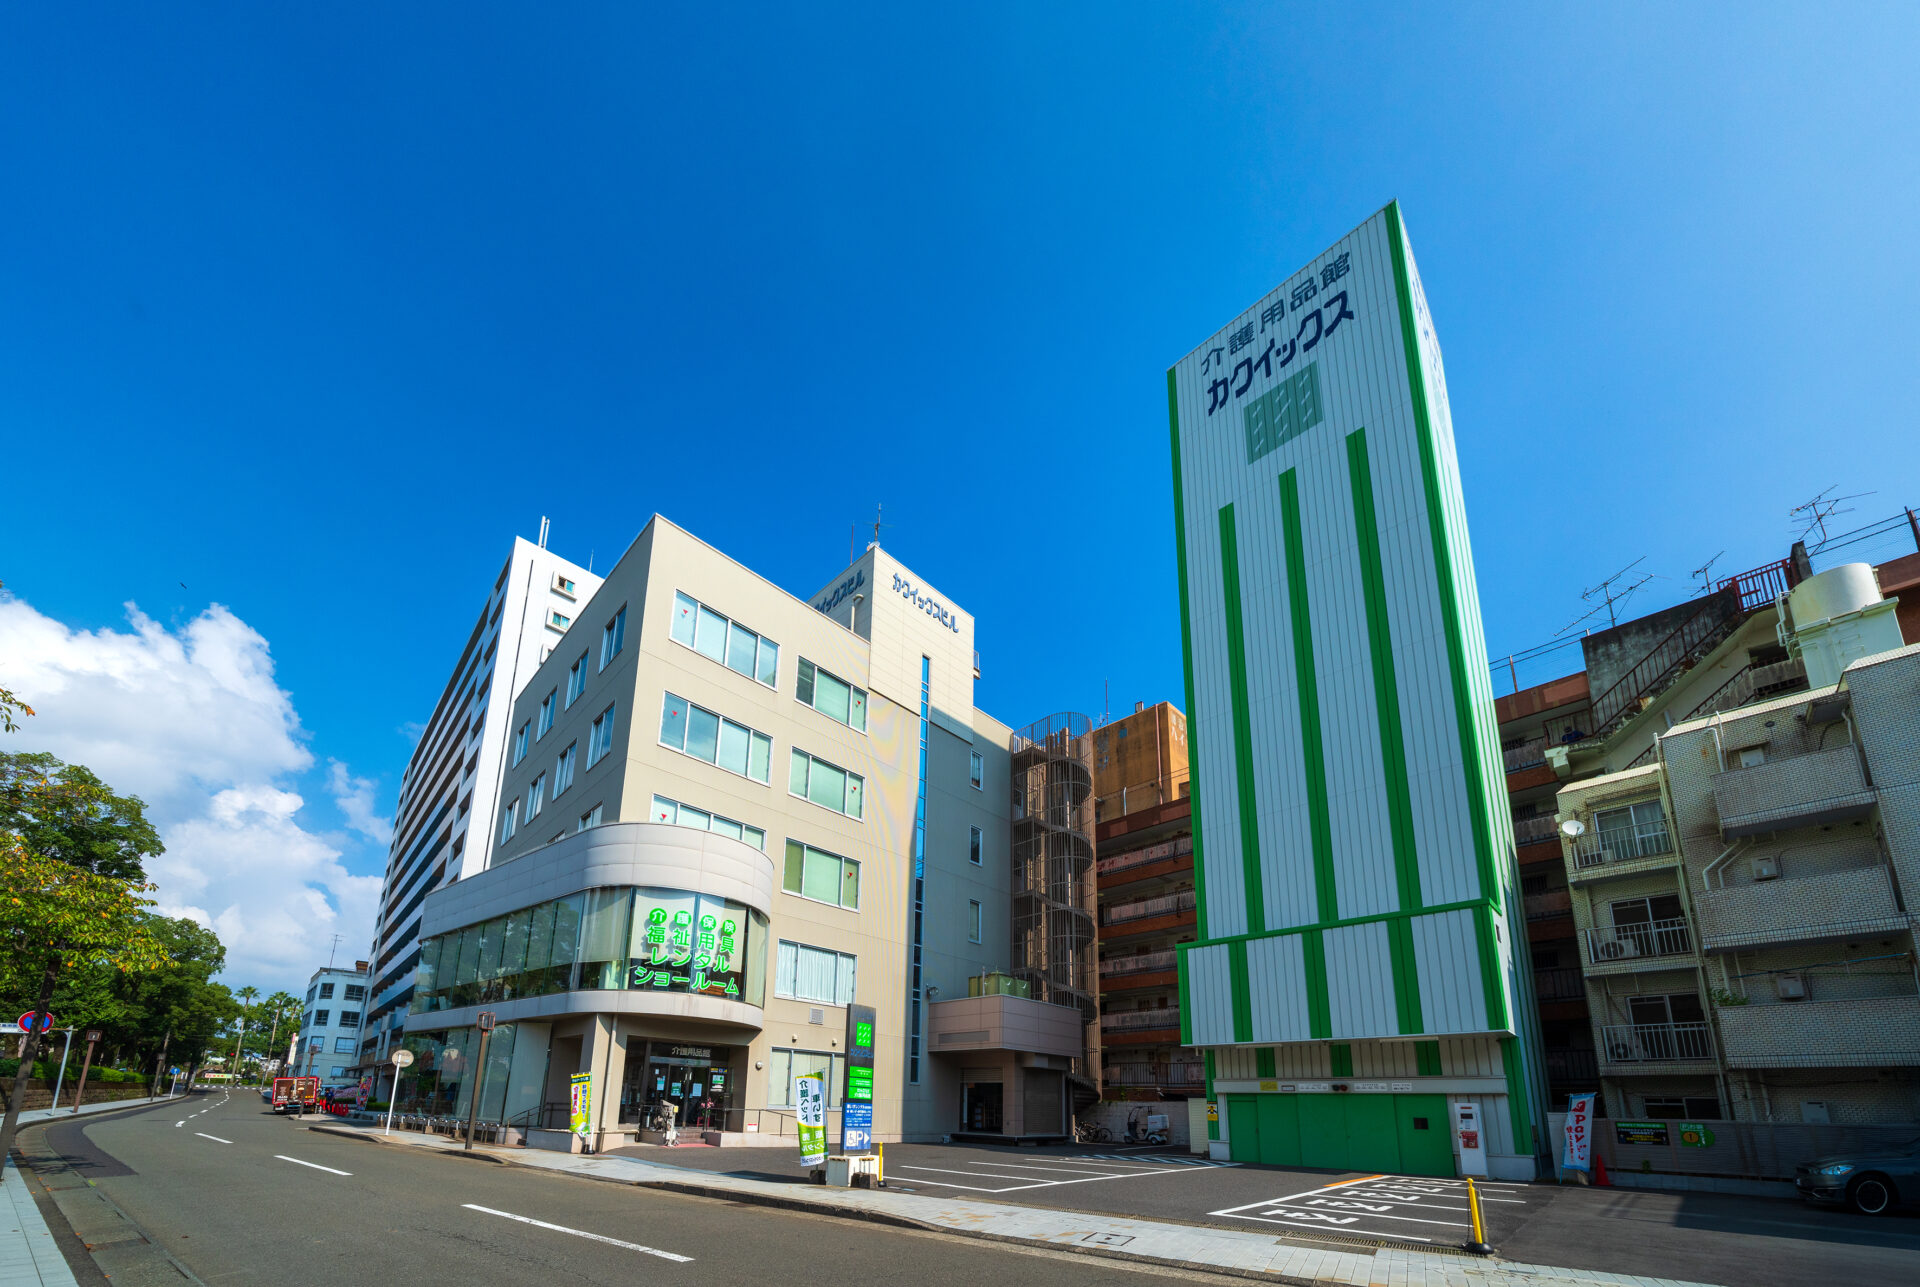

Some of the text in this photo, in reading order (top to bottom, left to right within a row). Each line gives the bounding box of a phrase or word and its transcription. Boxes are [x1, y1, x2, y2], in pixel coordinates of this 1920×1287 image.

[1201, 251, 1350, 376] 介護用品館
[1207, 290, 1354, 416] カクイックス
[893, 572, 959, 634] カクイックスビル
[649, 908, 736, 936] 介護保険
[647, 926, 734, 954] 福祉用具
[651, 947, 730, 973] レンタル
[634, 966, 739, 995] ショールーム
